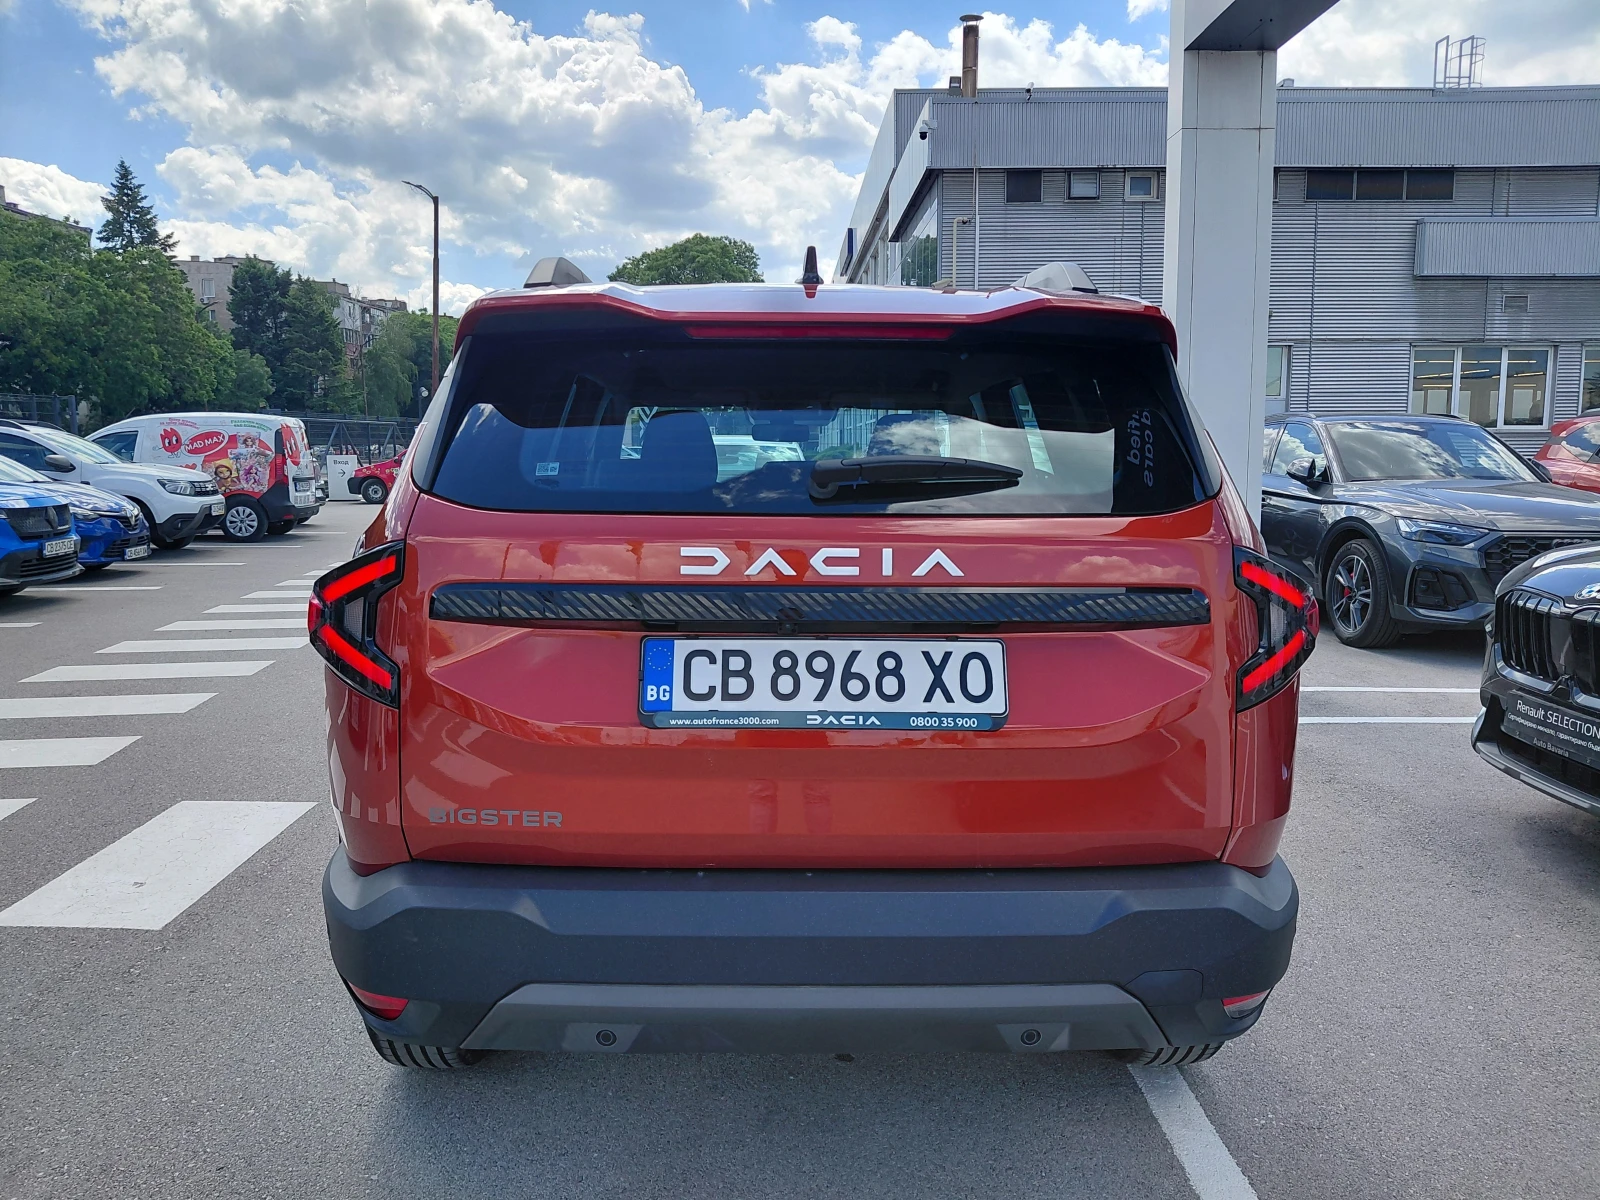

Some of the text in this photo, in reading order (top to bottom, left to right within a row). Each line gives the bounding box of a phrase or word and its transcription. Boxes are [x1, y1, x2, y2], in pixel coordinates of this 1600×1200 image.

[185, 434, 225, 452] MAD MAX
[680, 547, 965, 577] DACIA
[682, 649, 994, 703] CB 8968 XO
[646, 685, 671, 701] BG
[669, 716, 780, 725] www.autofrance3000.com
[806, 715, 881, 725] DACIA
[910, 716, 978, 728] 0800 35 900
[1516, 700, 1600, 740] Renault SELECTION
[1533, 737, 1569, 757] Auto Bavaria
[429, 807, 563, 828] BIGSTER
